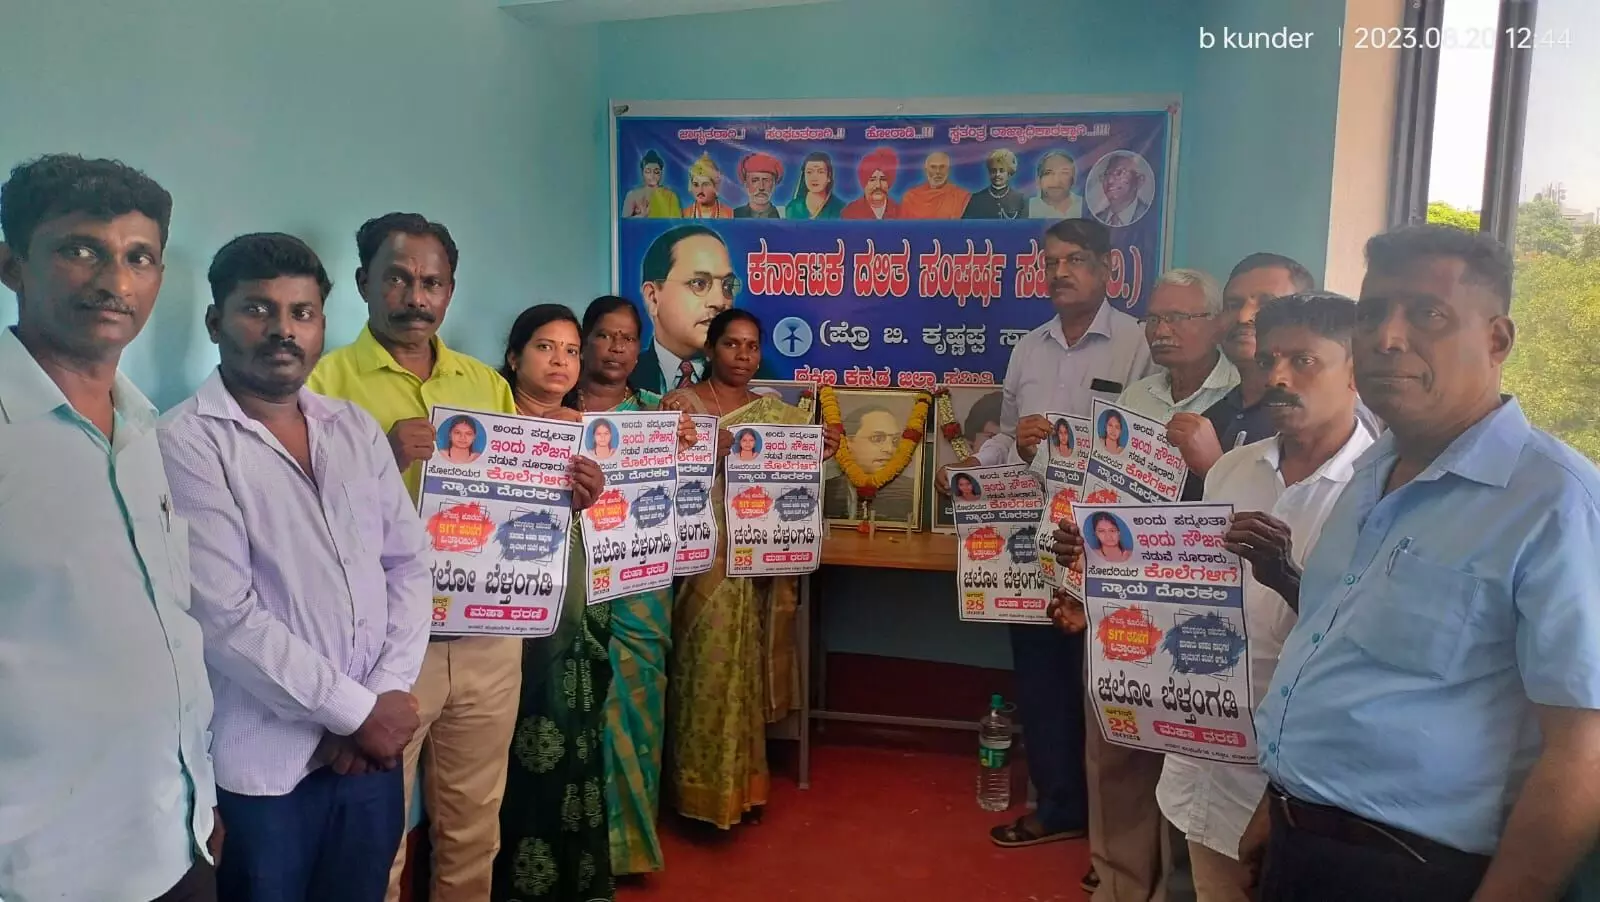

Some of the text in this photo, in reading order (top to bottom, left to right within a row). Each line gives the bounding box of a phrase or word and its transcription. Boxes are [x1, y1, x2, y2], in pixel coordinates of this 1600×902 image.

[748, 237, 846, 296] ಕರ್ನಾಟಕ
[854, 238, 911, 297] ದಲಿತ
[919, 238, 1007, 308] ಸಂಘರ್ಷ
[922, 323, 986, 355] ಕೃಷ್ಣಪ್ಪ
[844, 365, 892, 387] ಕನ್ನಡ
[492, 423, 576, 442] ಅಂದು ಪದ್ಮಲತಾ
[490, 439, 526, 454] ಇಂದು
[488, 454, 518, 466] ನಡುವೆ
[486, 466, 573, 487] ಕೊಲೆಗಳಿಗೆ
[442, 480, 561, 501] ನ್ಯಾಯ ದೊರಕಲಿ
[1133, 514, 1227, 528] ಅಂದು ಪದ್ಮಲತಾ
[679, 520, 711, 549] ಳ್ತಂಗಡಿ
[1137, 530, 1176, 549] ಇಂದು
[734, 555, 753, 566] 28
[1141, 551, 1173, 562] ನಡುವೆ
[1144, 563, 1238, 582] ಕೊಲೆಗಳಿಗೆ
[485, 564, 553, 604] ಬೆಳ್ತಂಗಡಿ
[592, 576, 610, 590] 28
[1101, 581, 1148, 599] ನ್ಯಾಯ
[1155, 583, 1228, 601] ದೊರಕಲಿ
[966, 600, 985, 611] 28
[1107, 628, 1125, 641] SIT
[1097, 669, 1239, 725] ಚಲೋ ಬೆಳ್ತಂಗಡಿ
[1107, 717, 1139, 735] 28
